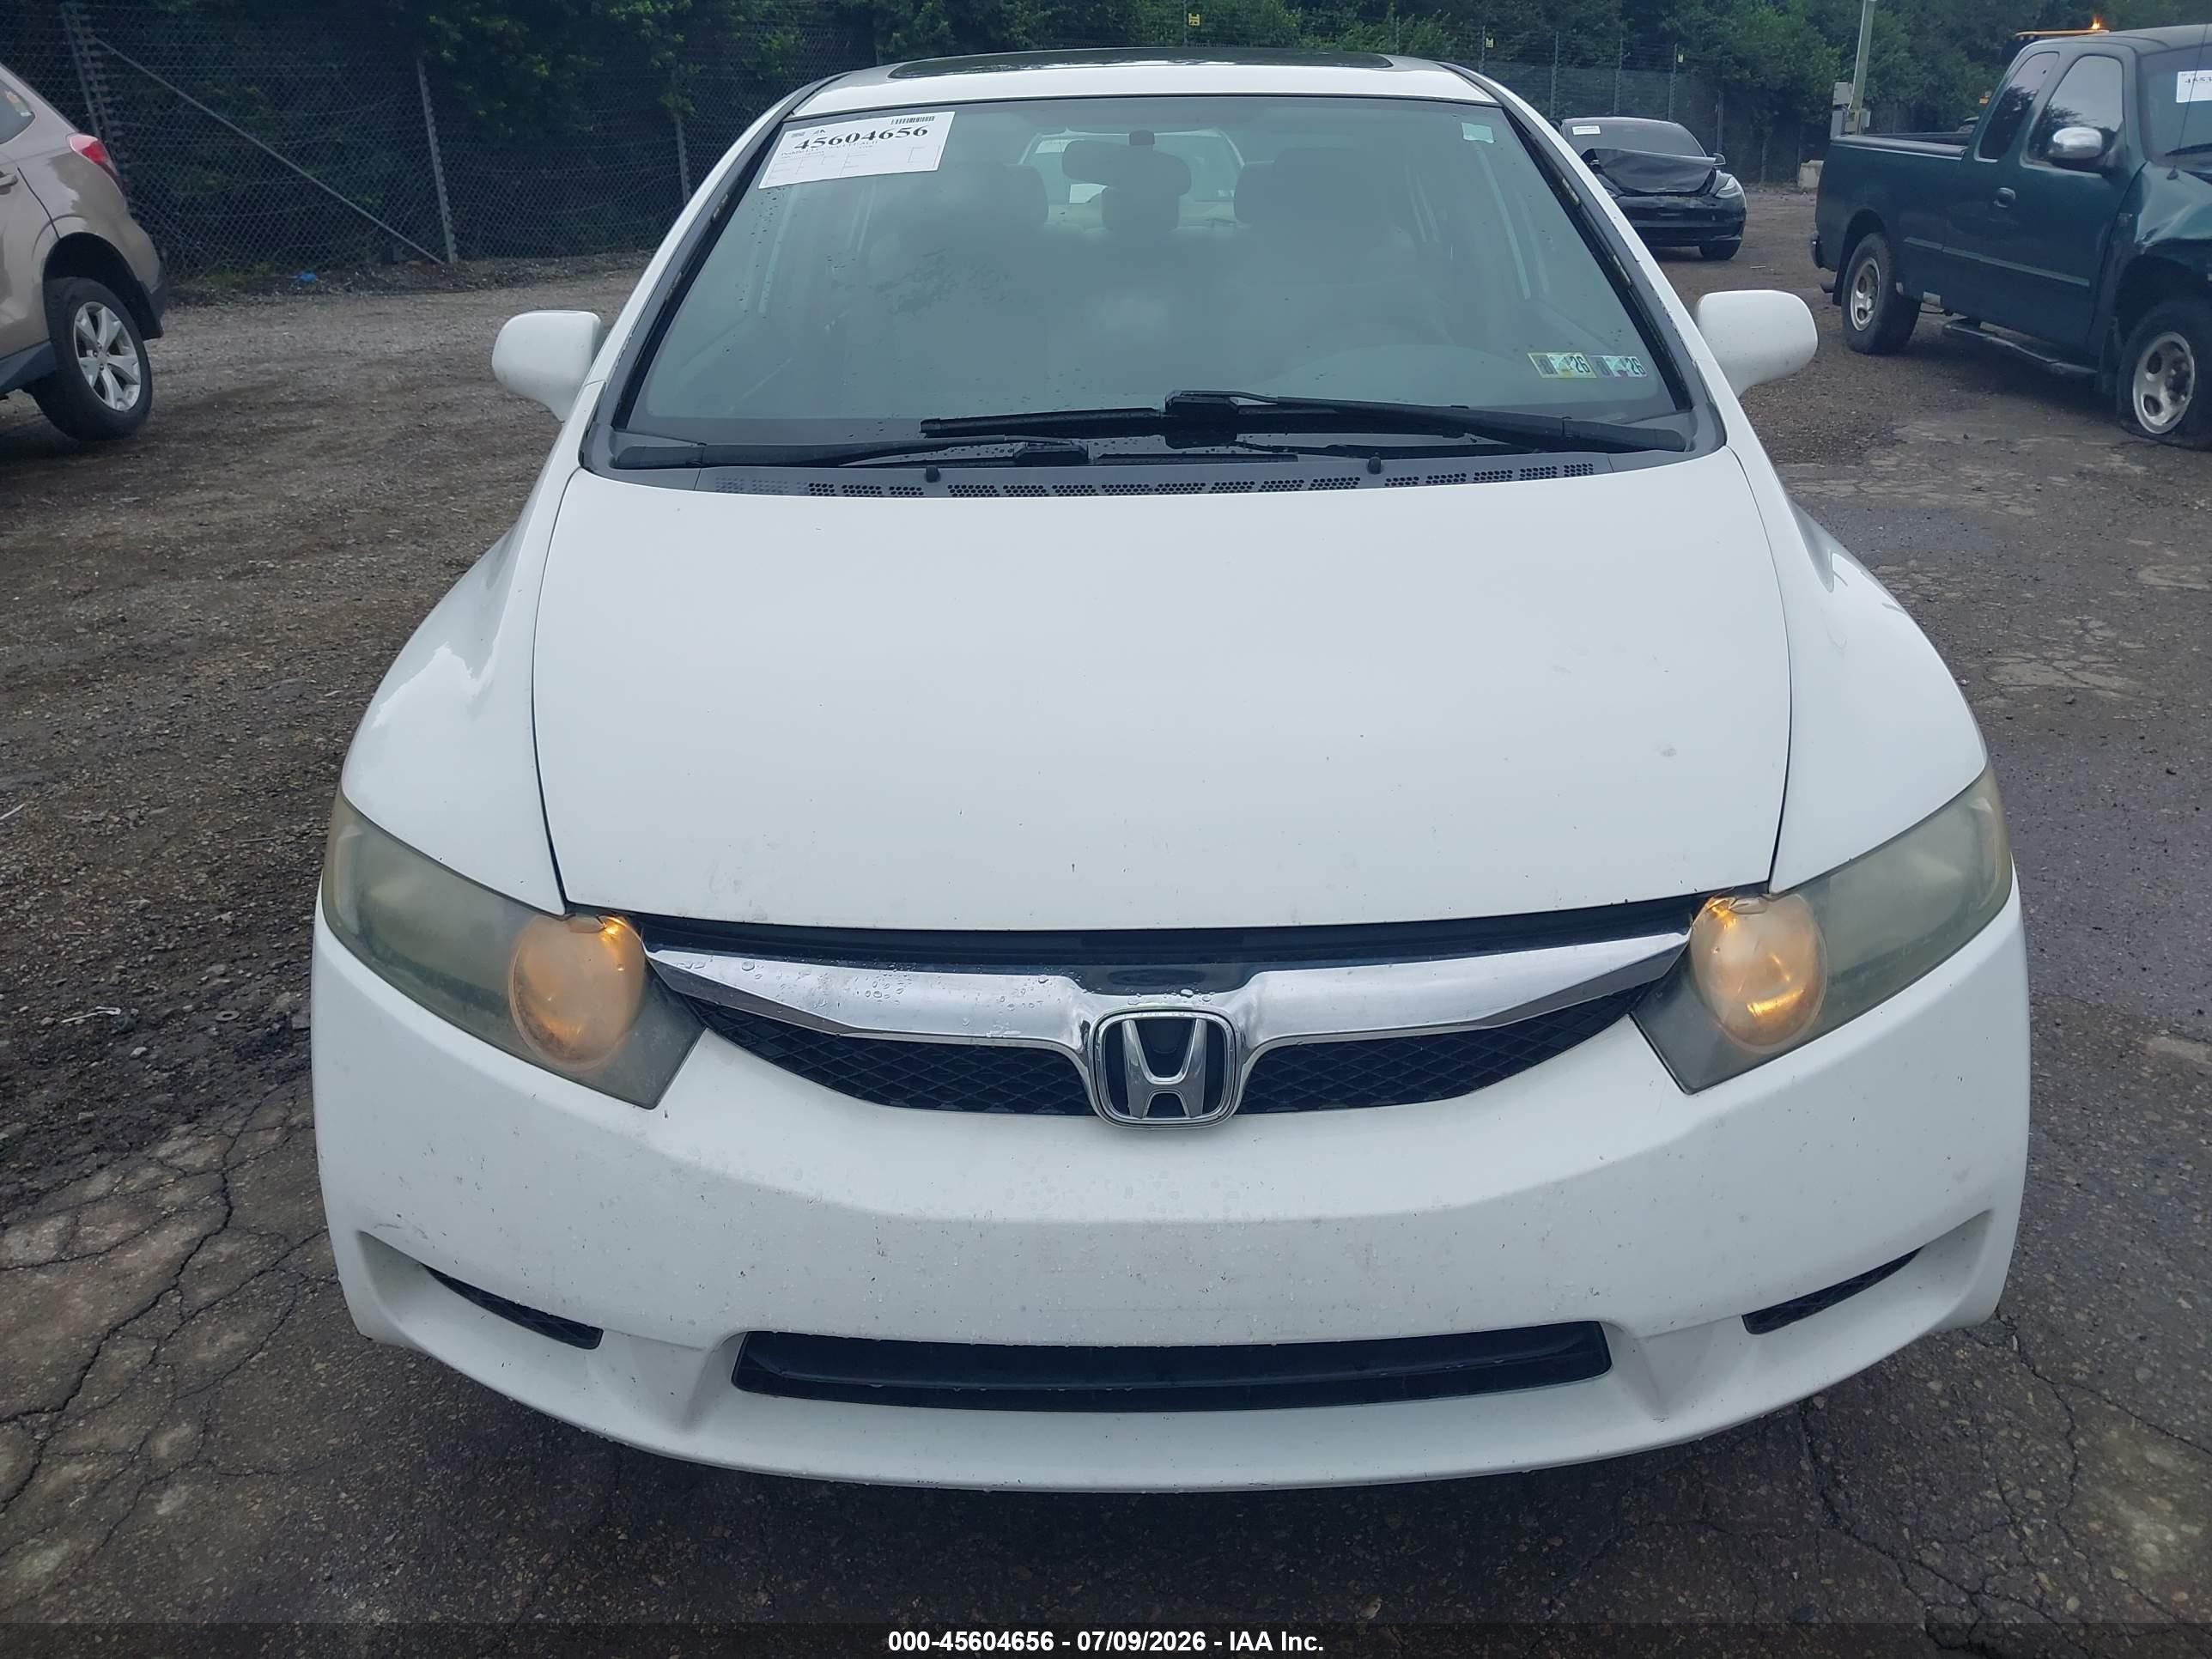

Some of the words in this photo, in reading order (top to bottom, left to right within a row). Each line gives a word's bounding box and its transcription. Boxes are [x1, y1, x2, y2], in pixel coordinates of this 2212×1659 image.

[794, 125, 929, 151] 45604656
[1571, 356, 1591, 374] 26
[1626, 356, 1646, 375] 26
